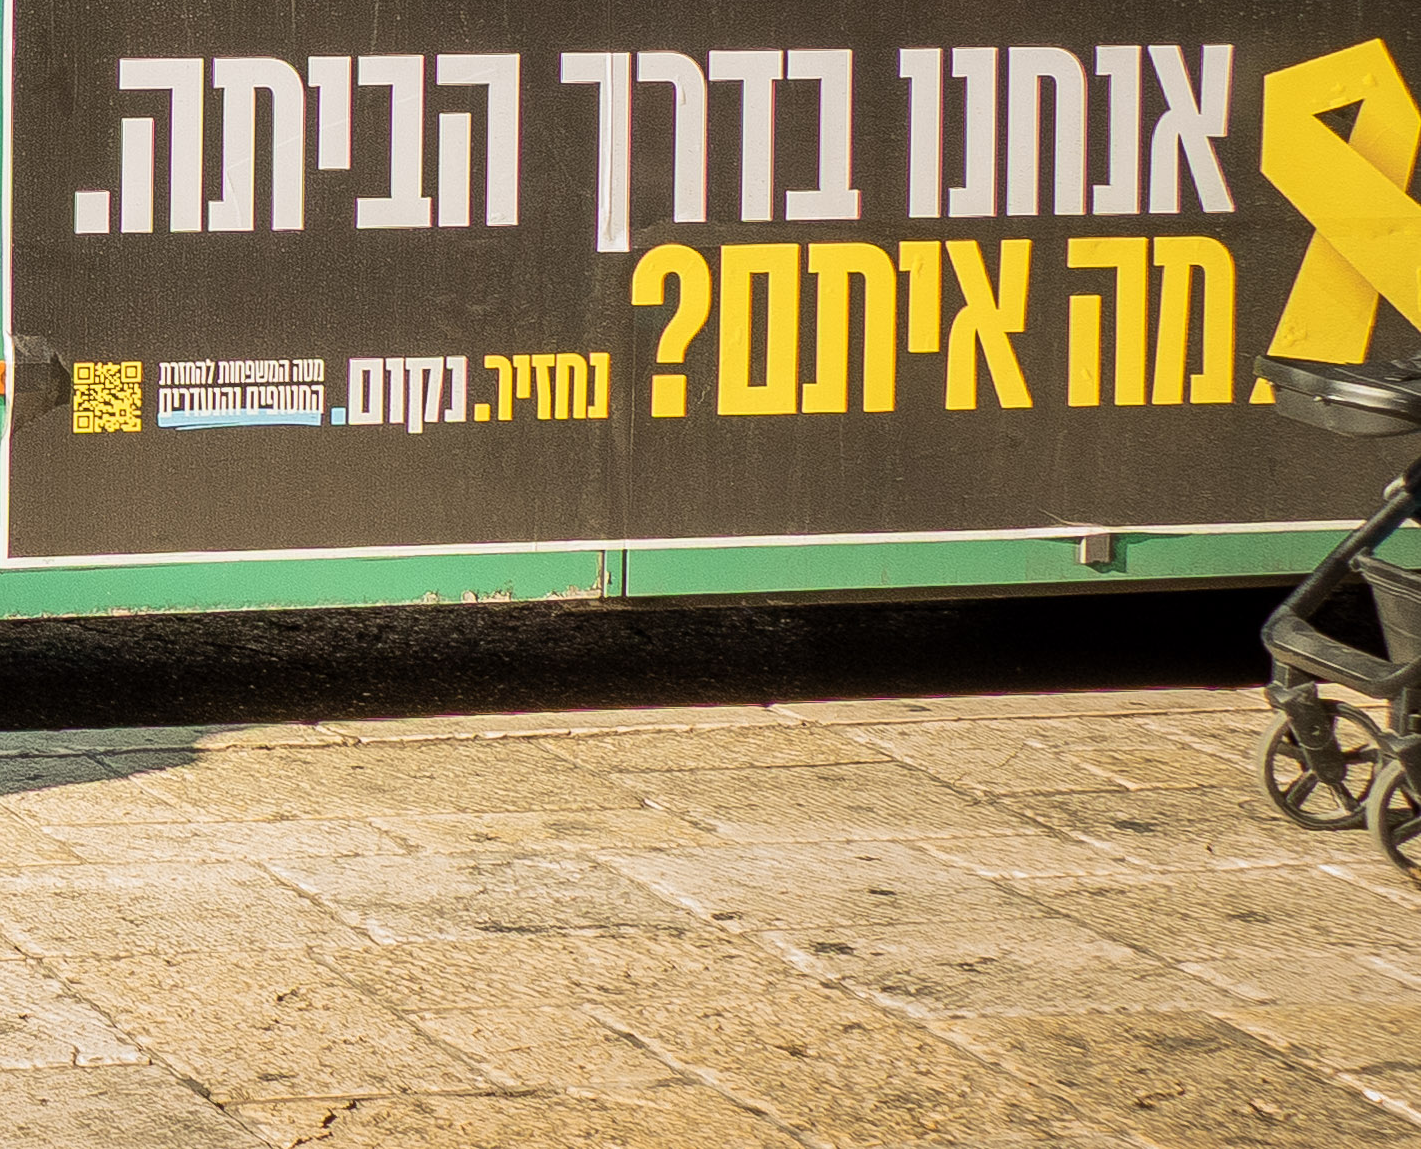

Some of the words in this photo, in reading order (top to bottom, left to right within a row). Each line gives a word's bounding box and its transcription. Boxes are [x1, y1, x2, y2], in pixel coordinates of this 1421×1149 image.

[74, 53, 519, 233] הביתה.
[559, 49, 860, 252] בדרך
[899, 44, 1234, 218] אנחנו
[631, 239, 1033, 418] איתם?
[1067, 236, 1235, 407] מה
[159, 358, 216, 385] להחזרת
[159, 386, 241, 418] והנעדרים
[218, 359, 289, 384] המשפחות
[246, 385, 324, 415] החטופים
[293, 358, 324, 382] מטה
[331, 355, 467, 434] נקום.
[474, 352, 610, 422] נחזיר.
